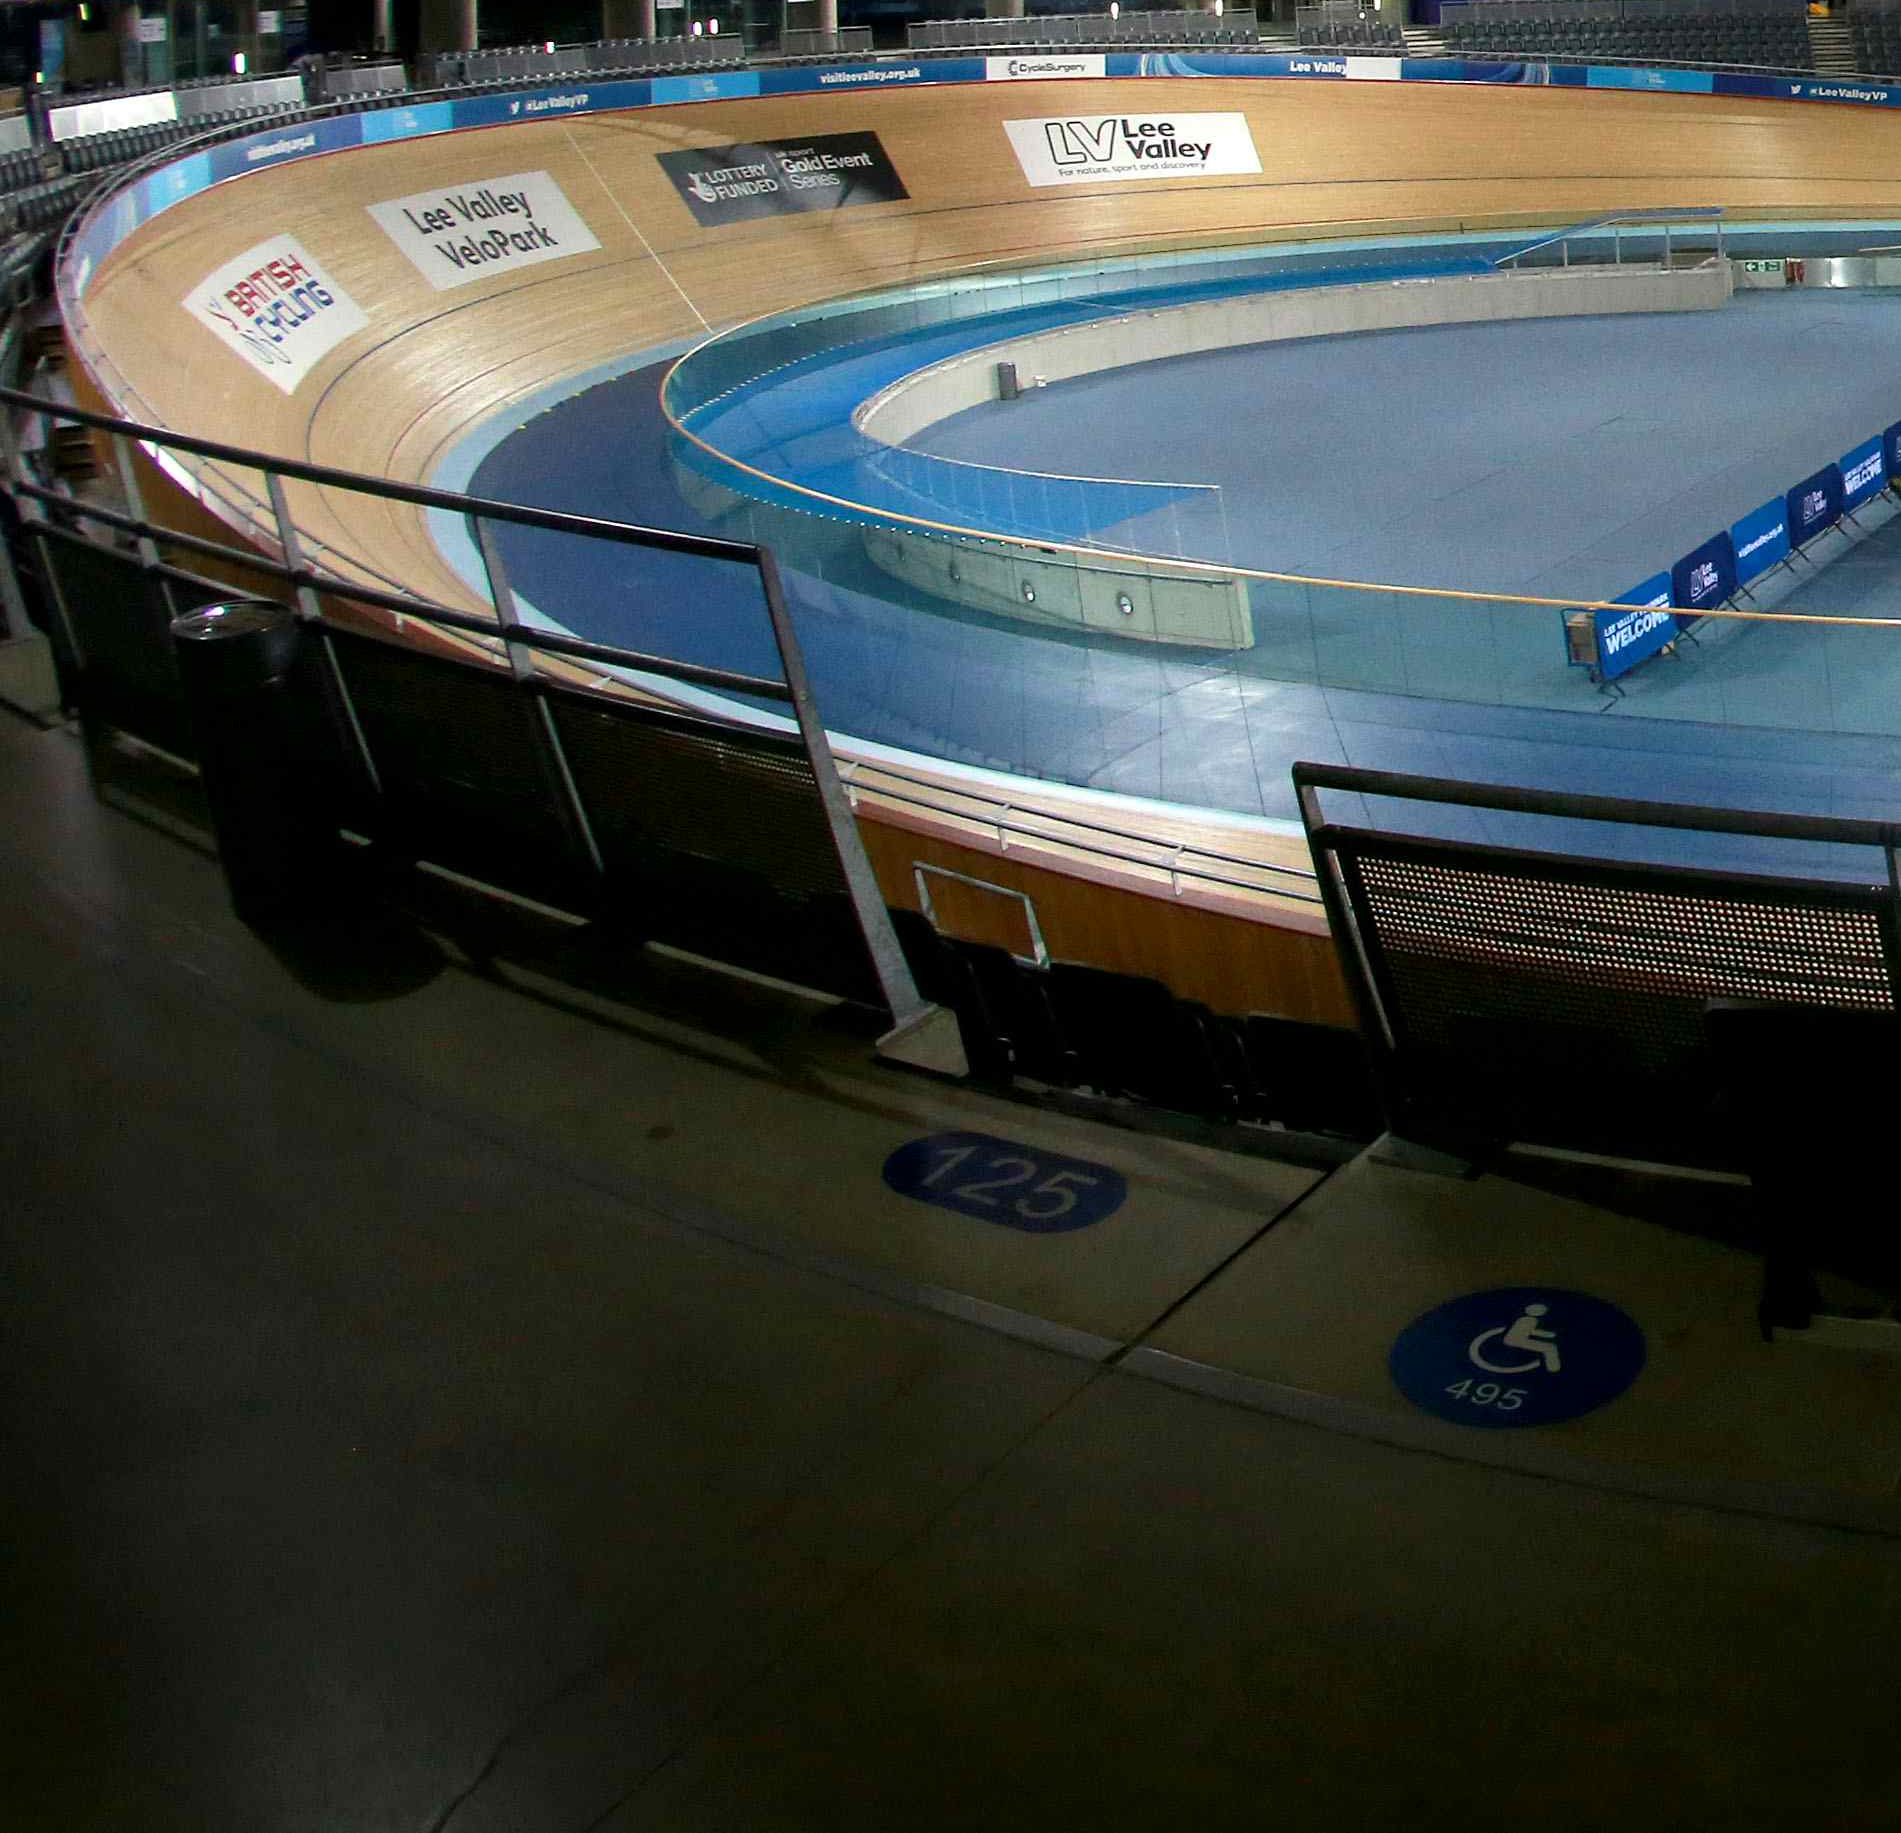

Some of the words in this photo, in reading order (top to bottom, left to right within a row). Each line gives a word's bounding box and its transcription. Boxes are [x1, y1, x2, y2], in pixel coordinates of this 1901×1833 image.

[820, 67, 920, 84] visitleevalley.org.uk
[1019, 62, 1087, 75] CycleSurgery
[1290, 61, 1310, 72] Lee
[1810, 87, 1887, 101] @LeeValleyVP
[1122, 120, 1175, 138] Lee
[1125, 140, 1212, 161] Valley
[782, 155, 824, 173] Gold
[821, 152, 873, 169] Event
[705, 163, 767, 184] LOTTERY
[790, 173, 840, 188] Series
[716, 178, 778, 201] FUNDED
[404, 203, 455, 235] Lee
[447, 189, 533, 223] Valley
[439, 223, 559, 270] VeloPark
[224, 254, 312, 317] BRITISH
[254, 280, 334, 342] CYCLING
[1605, 602, 1670, 654] WELCOME
[919, 1144, 1100, 1219] 125
[1442, 1378, 1527, 1411] 495
